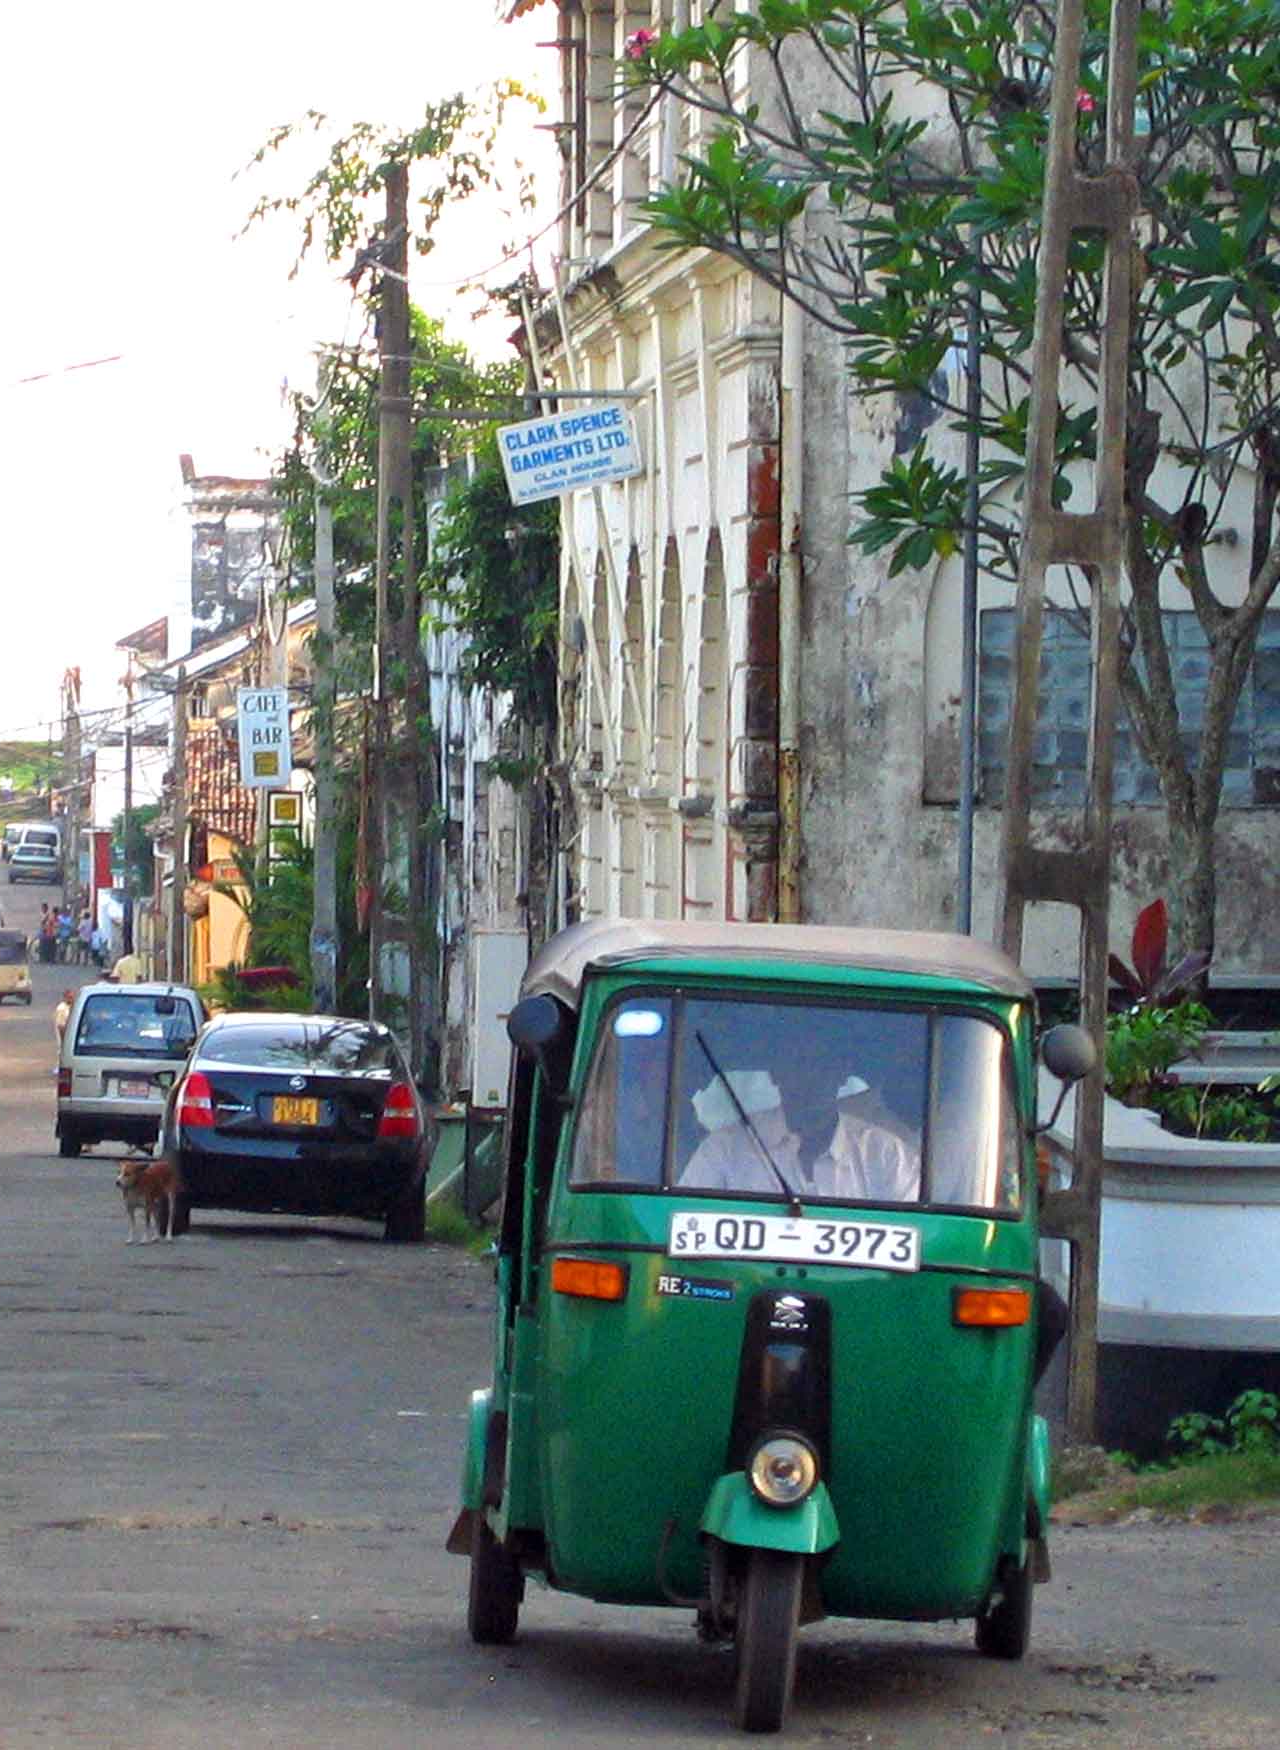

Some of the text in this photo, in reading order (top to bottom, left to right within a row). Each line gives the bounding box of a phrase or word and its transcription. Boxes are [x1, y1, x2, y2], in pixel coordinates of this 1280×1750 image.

[506, 408, 622, 450] CLARK SPENCE
[511, 440, 593, 472] GARMENTS
[533, 467, 568, 483] CLAN
[253, 728, 282, 744] BAR
[675, 1231, 707, 1251] SP
[657, 1276, 681, 1294] RE
[683, 1281, 693, 1296] 2
